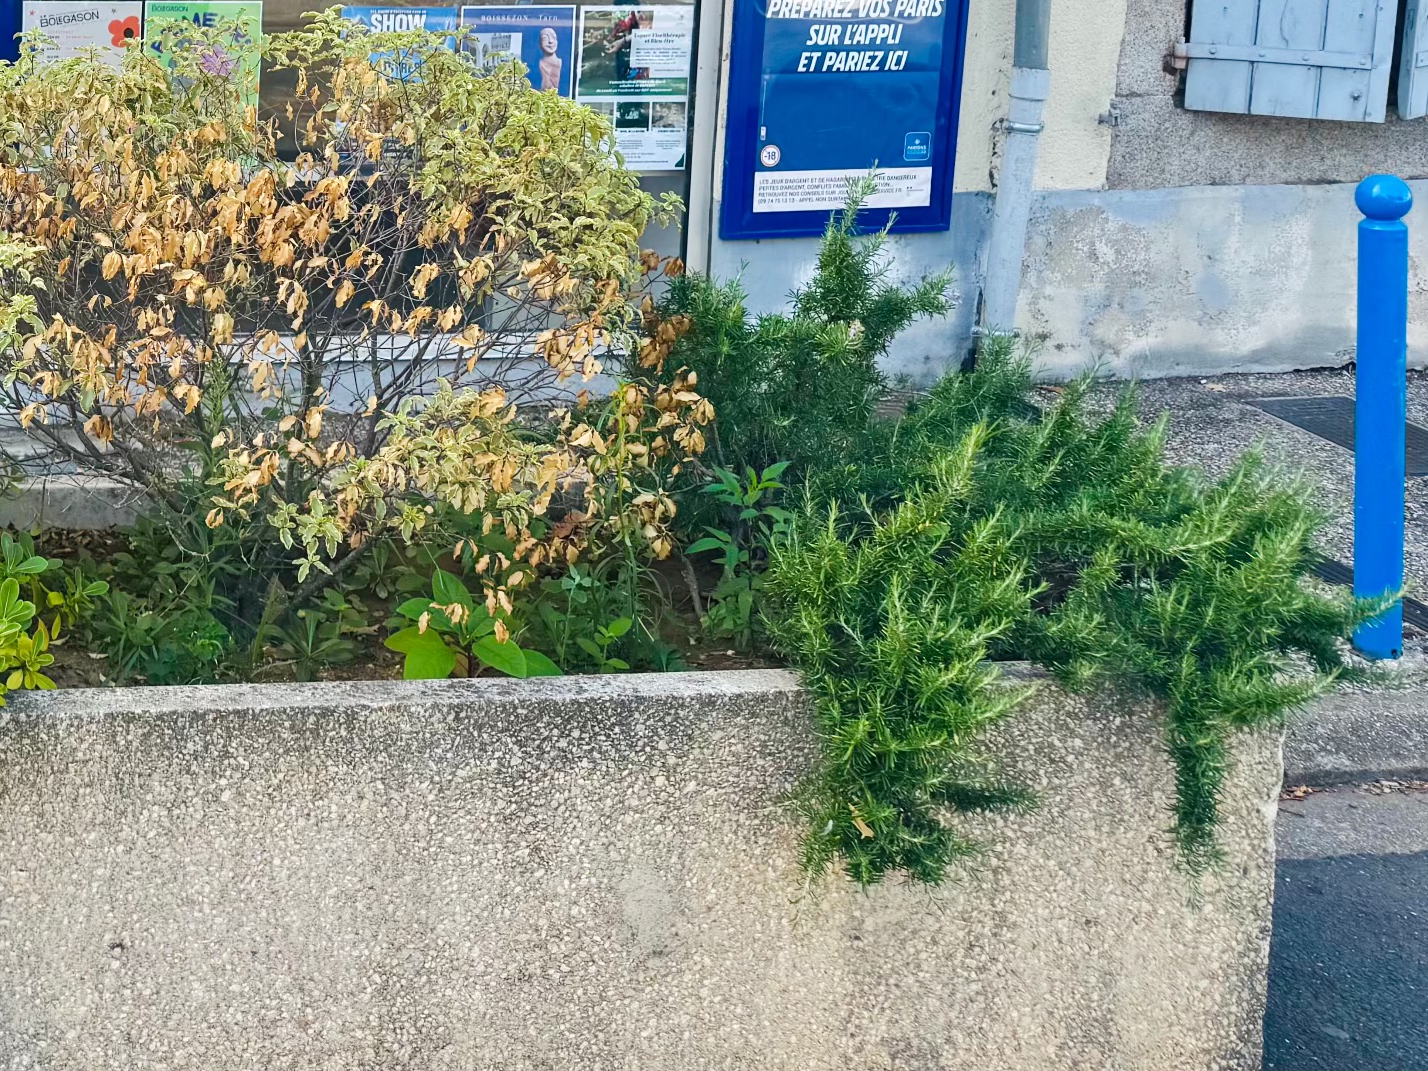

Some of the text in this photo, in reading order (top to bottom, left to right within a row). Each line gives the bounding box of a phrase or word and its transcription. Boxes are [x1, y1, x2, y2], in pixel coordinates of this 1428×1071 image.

[40, 10, 99, 28] BOLEGASON
[370, 13, 427, 33] SHOW
[806, 23, 904, 46] SUR L'APPLI
[797, 50, 908, 72] ET PARIEZ ICI
[763, 151, 776, 160] -18
